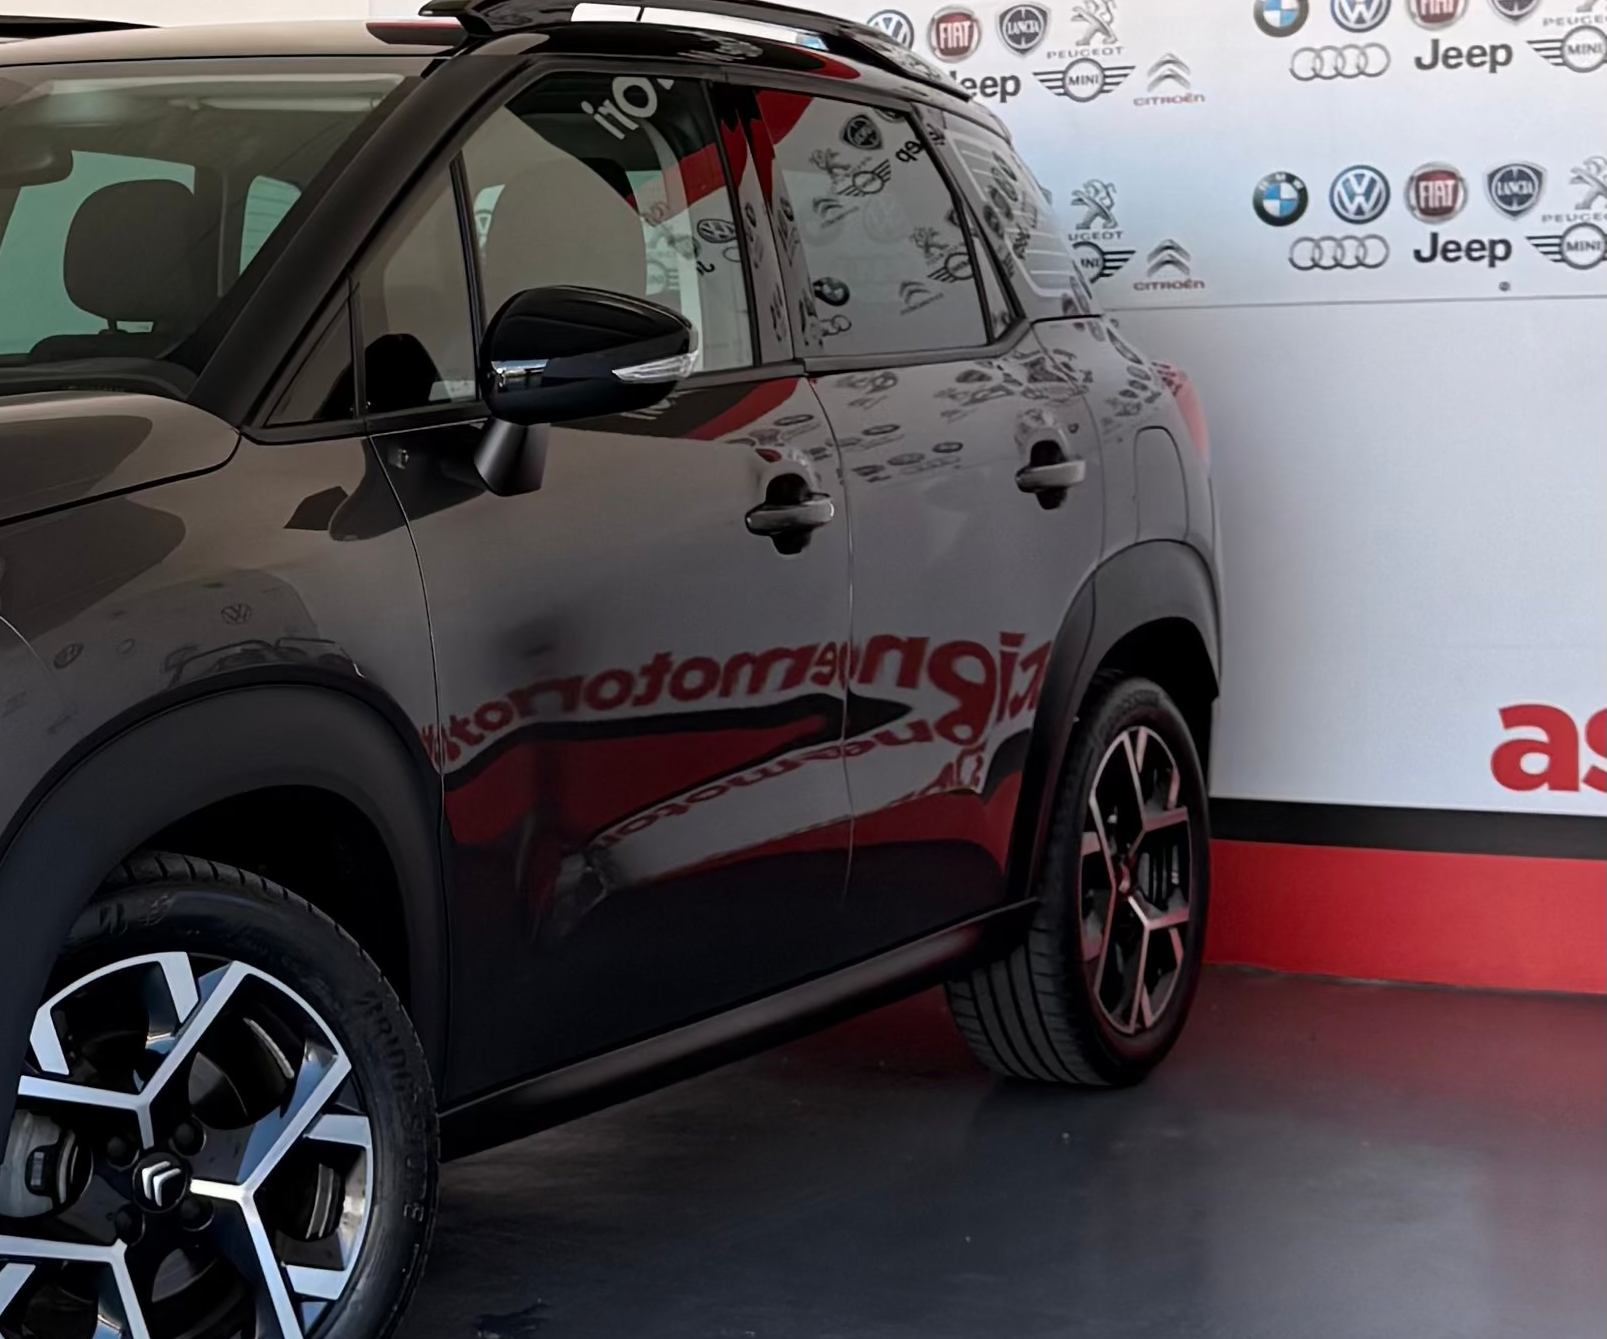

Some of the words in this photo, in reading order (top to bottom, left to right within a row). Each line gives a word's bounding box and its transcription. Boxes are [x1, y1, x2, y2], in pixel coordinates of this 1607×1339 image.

[938, 21, 972, 49] FIAT
[1046, 45, 1124, 60] PEUGEOT
[1413, 38, 1514, 74] Jeep
[1567, 43, 1603, 55] MINI
[1067, 72, 1100, 87] MINI
[1419, 179, 1455, 209] FIAT
[1412, 232, 1512, 268] Jeep
[1566, 241, 1601, 252] MINI
